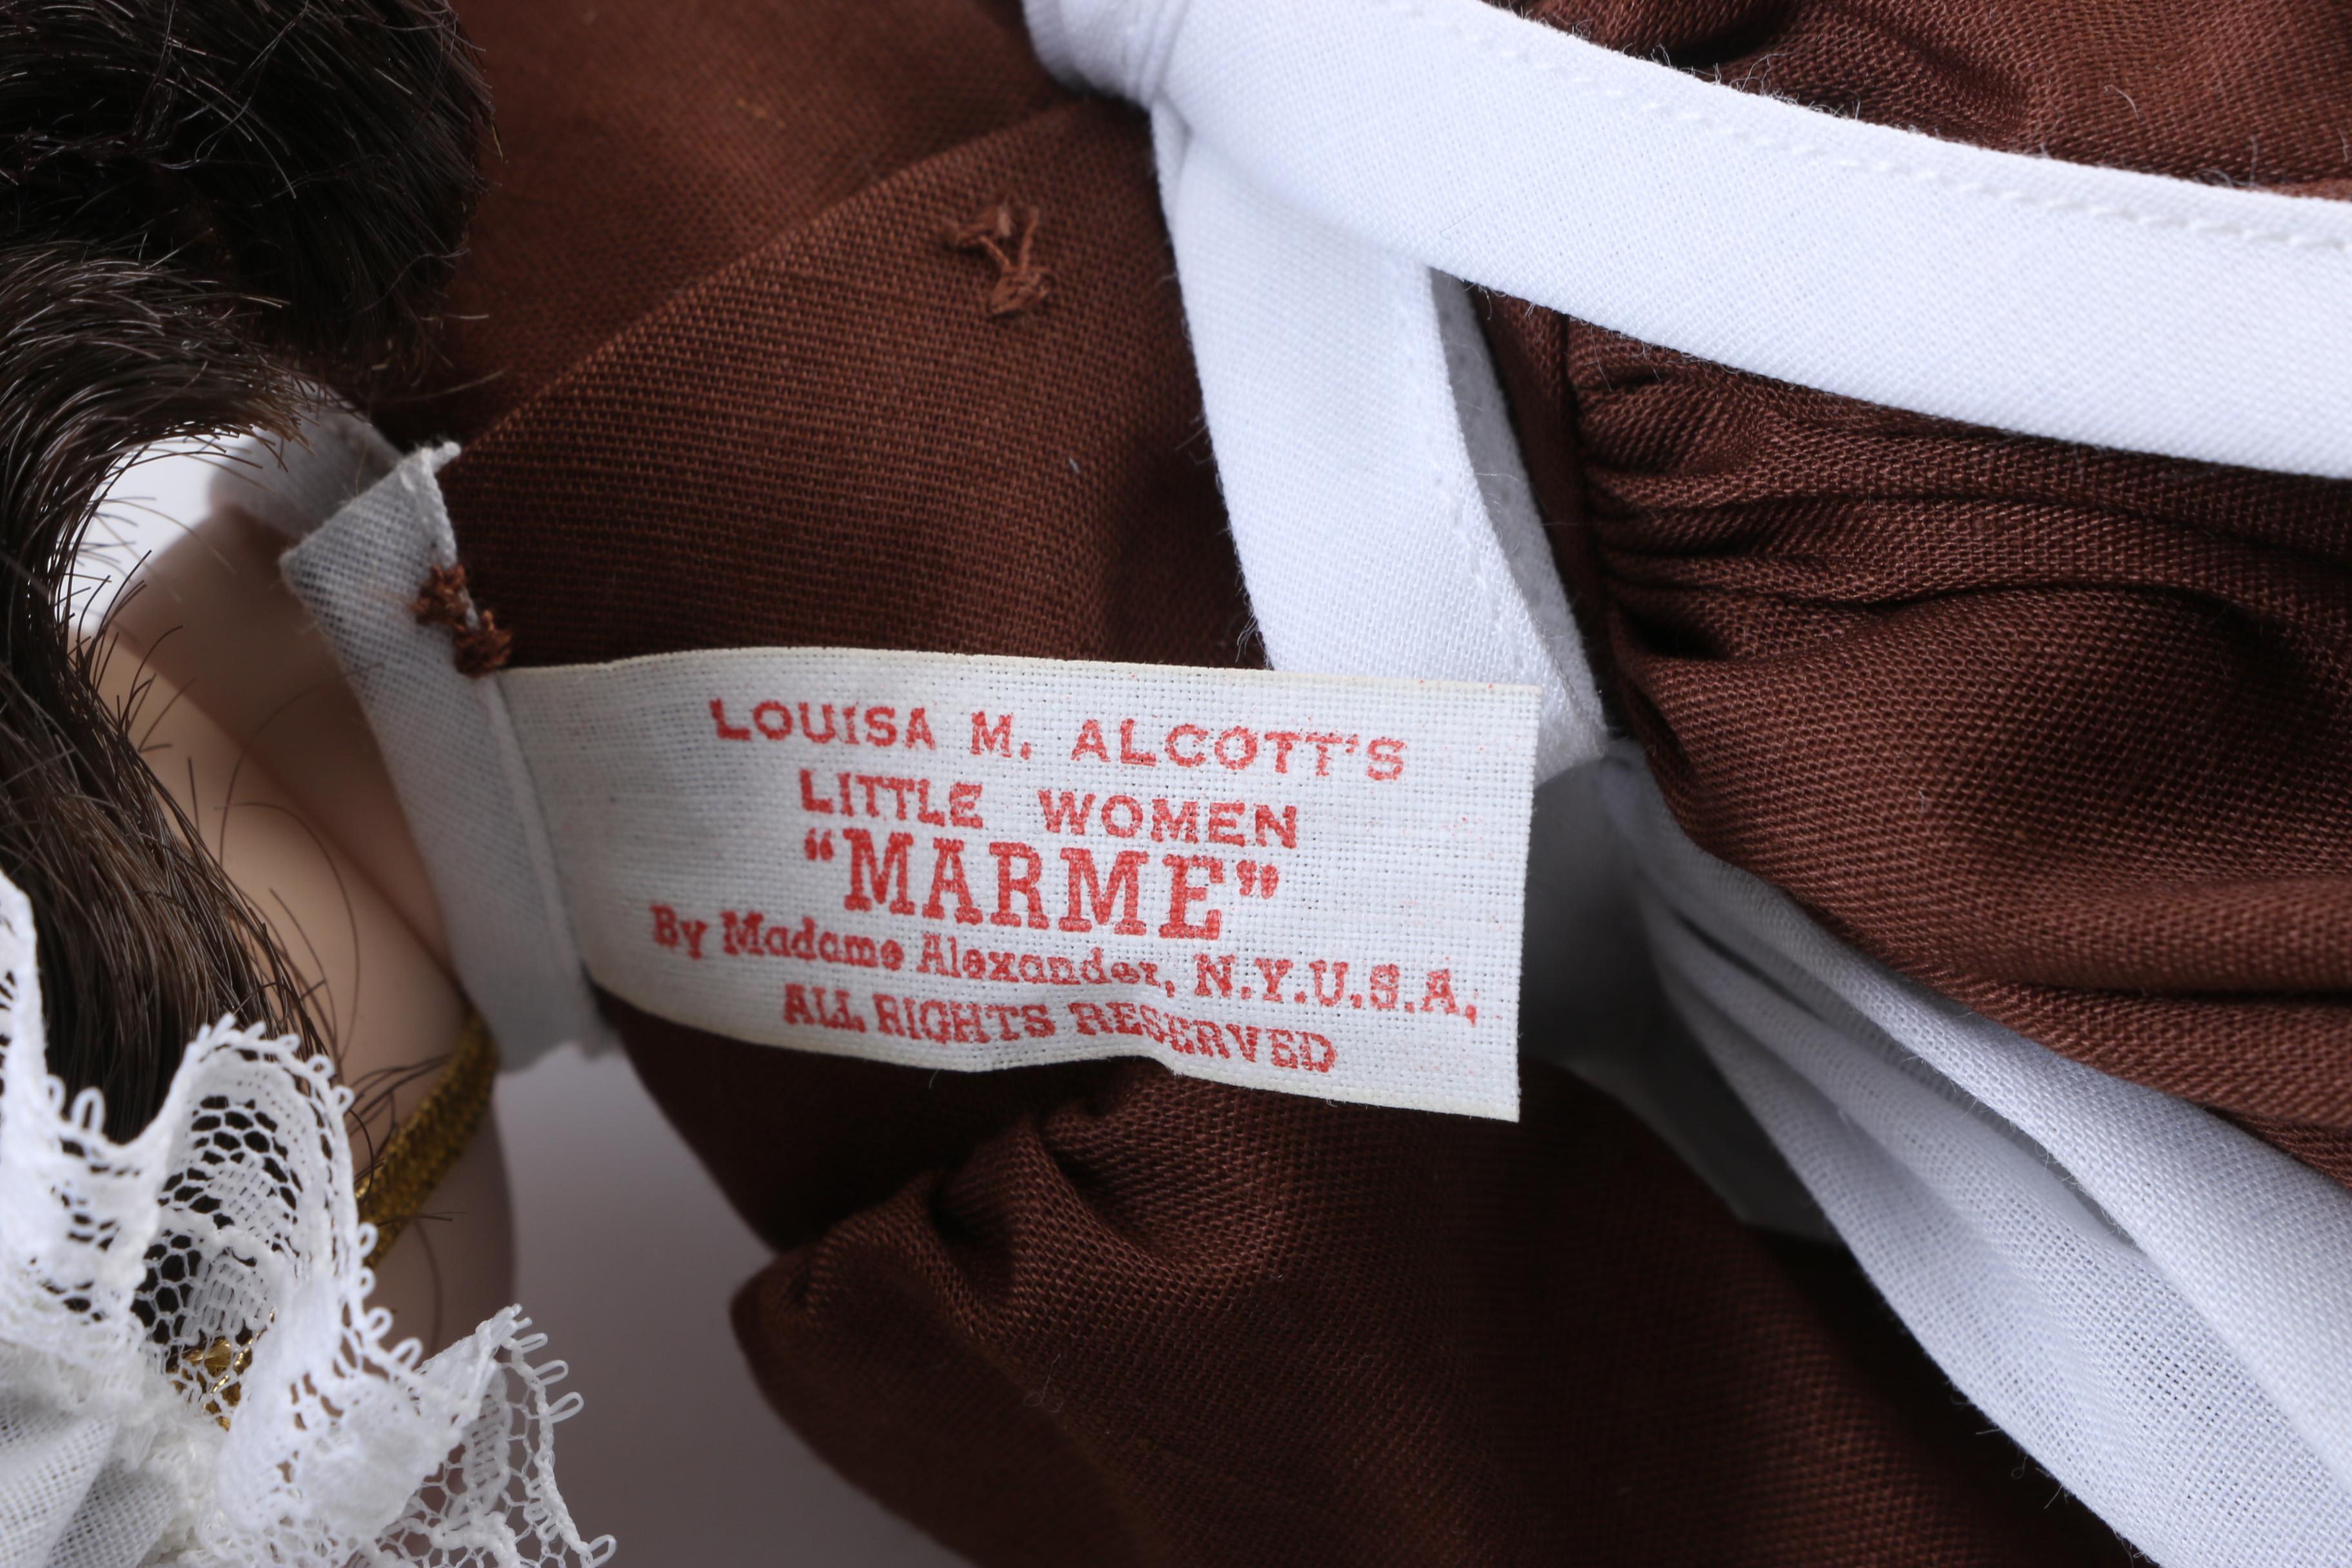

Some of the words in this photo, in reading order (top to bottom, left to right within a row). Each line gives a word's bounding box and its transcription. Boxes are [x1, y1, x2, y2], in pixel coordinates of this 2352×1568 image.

[709, 697, 935, 750] LOUISA
[970, 712, 1032, 760] M.
[1070, 718, 1408, 781] ALCOTT'S
[799, 769, 983, 828] LITTLE
[1037, 789, 1298, 848] WOMEN
[651, 905, 707, 959] By
[720, 912, 904, 971] Madame
[783, 984, 865, 1033] ALL
[873, 993, 1056, 1044] RIGHTS
[1069, 1001, 1337, 1073] RESERVED
